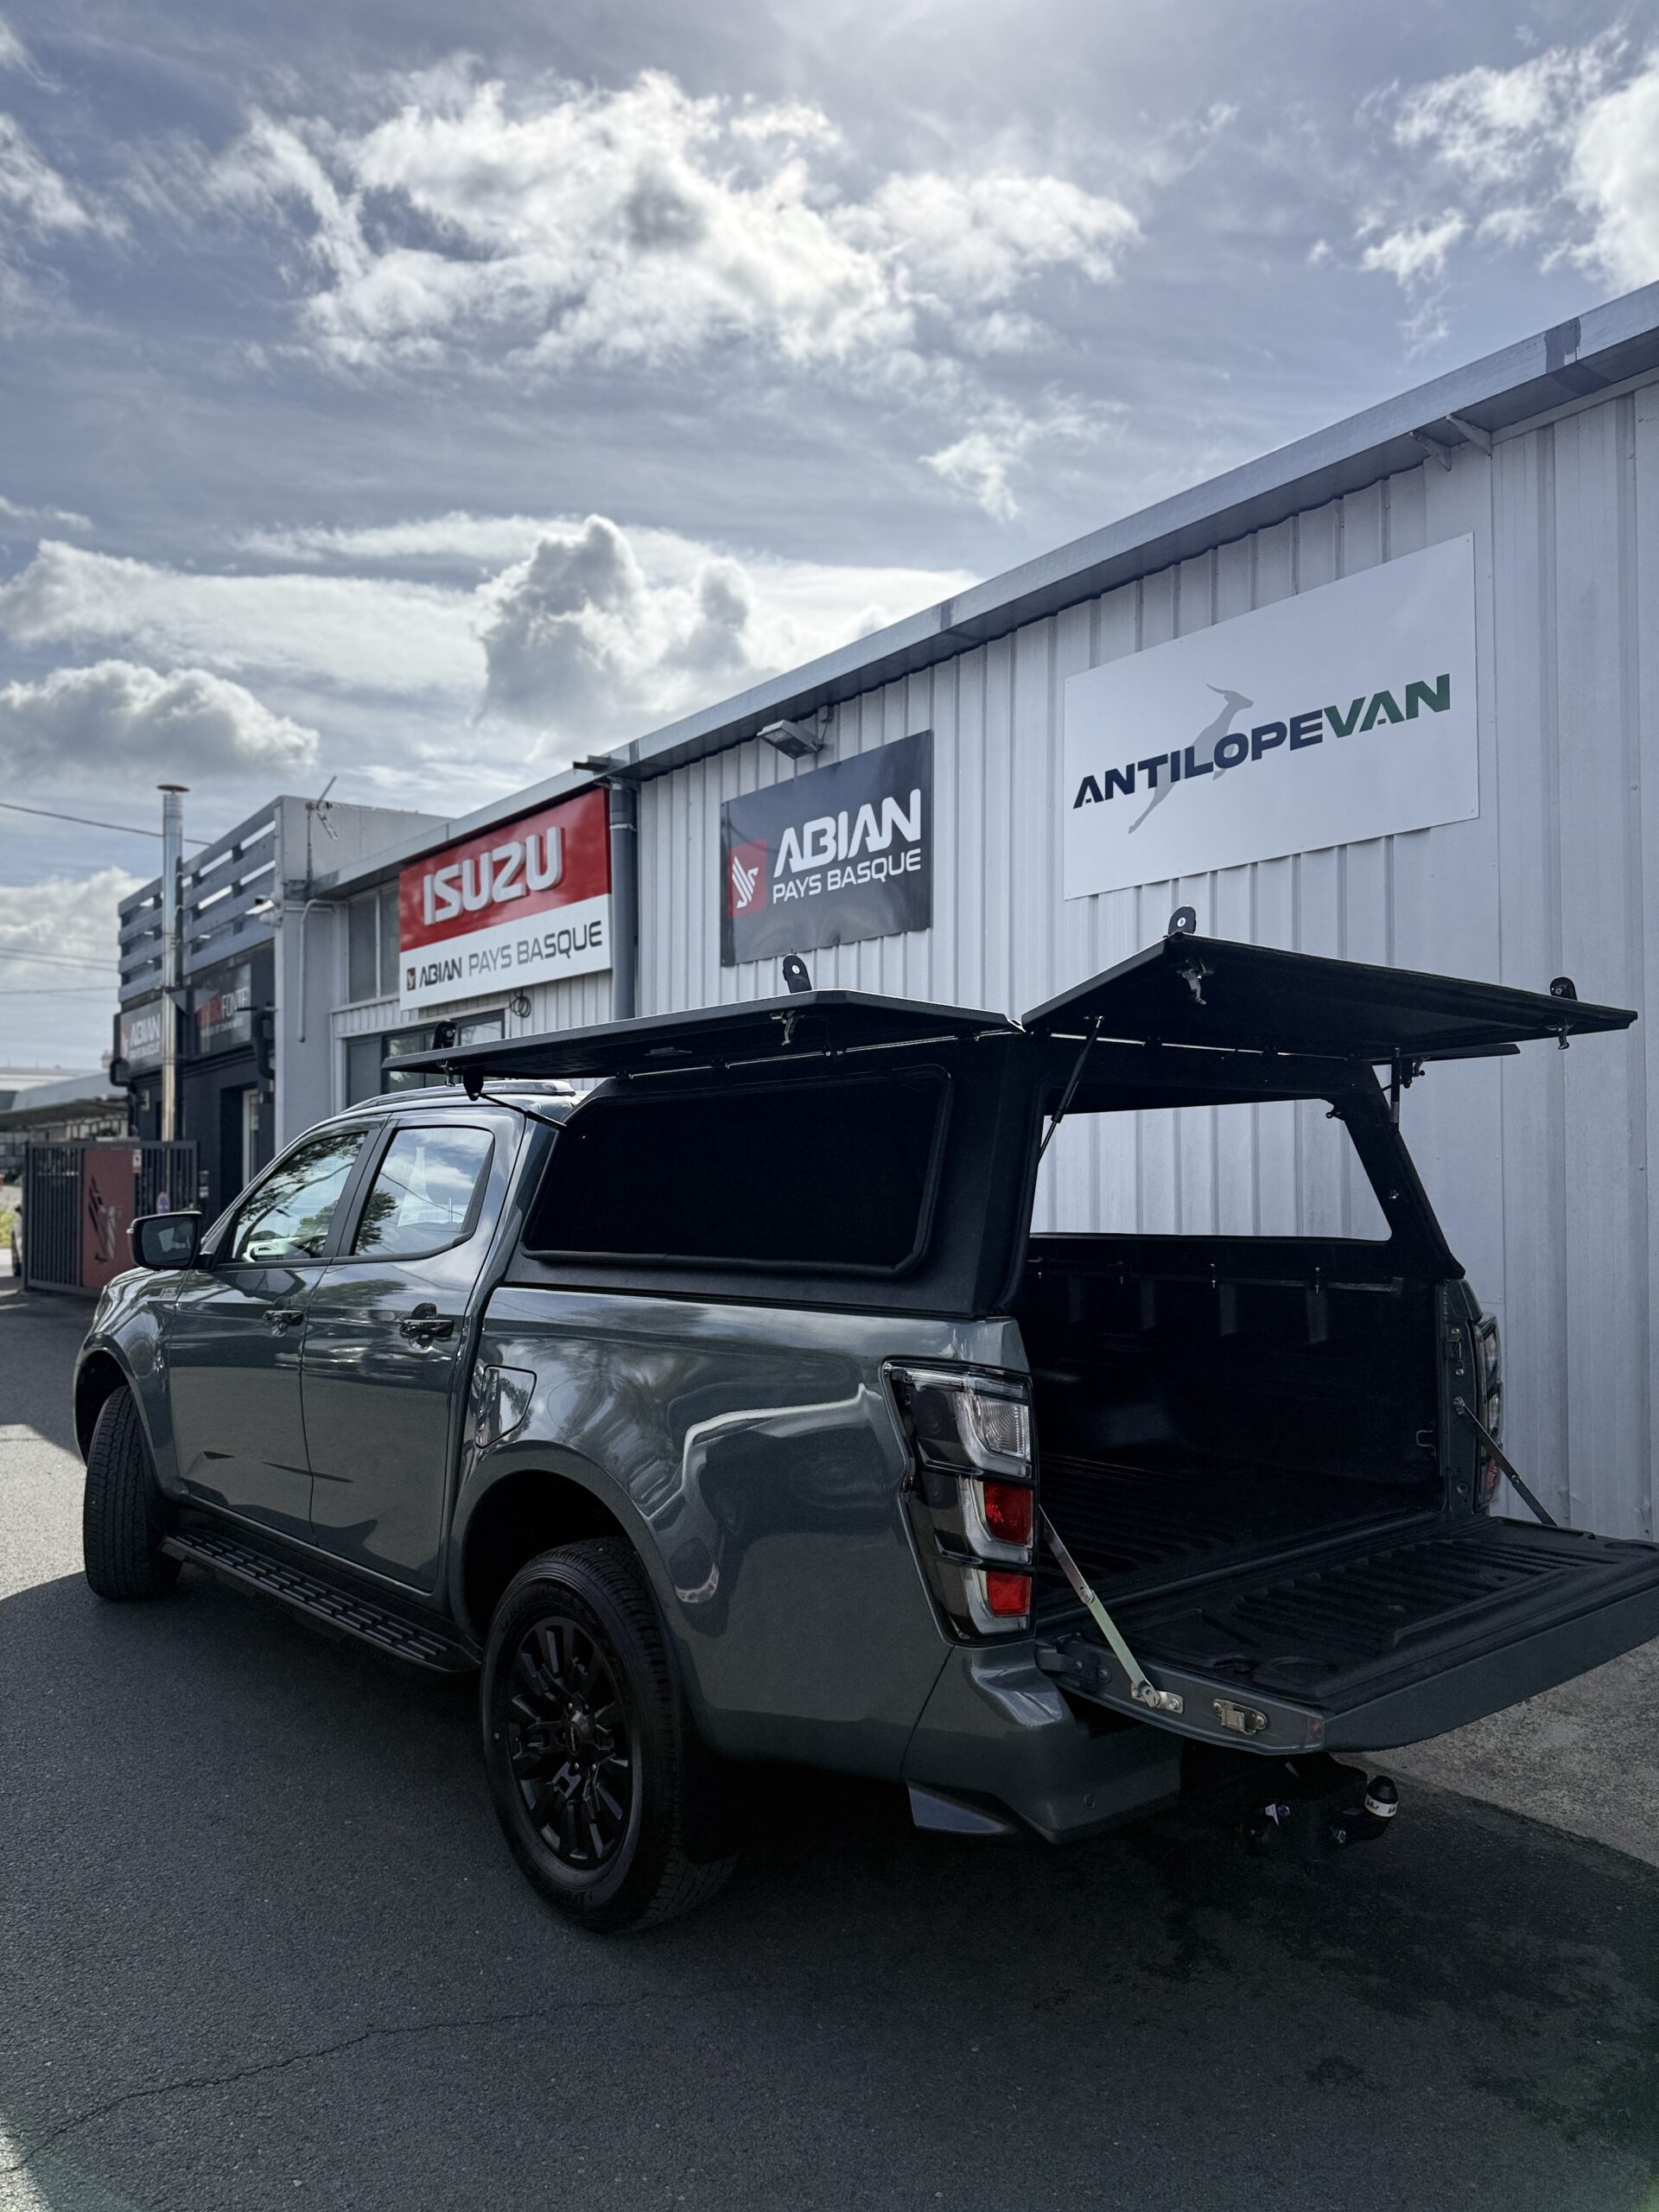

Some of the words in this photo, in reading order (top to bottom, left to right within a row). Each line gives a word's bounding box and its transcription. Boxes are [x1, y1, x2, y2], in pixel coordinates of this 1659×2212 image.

[1072, 672, 1451, 810] ANTILOPEVAN
[772, 788, 922, 879] ABIAN
[423, 825, 563, 926] ISUZU
[772, 873, 822, 905] PAYS
[827, 848, 922, 892] BASQUE
[419, 956, 463, 988] ABIAN
[468, 944, 512, 977] PAYS
[517, 919, 603, 966] BASQUE
[129, 1013, 162, 1048] ABIAN
